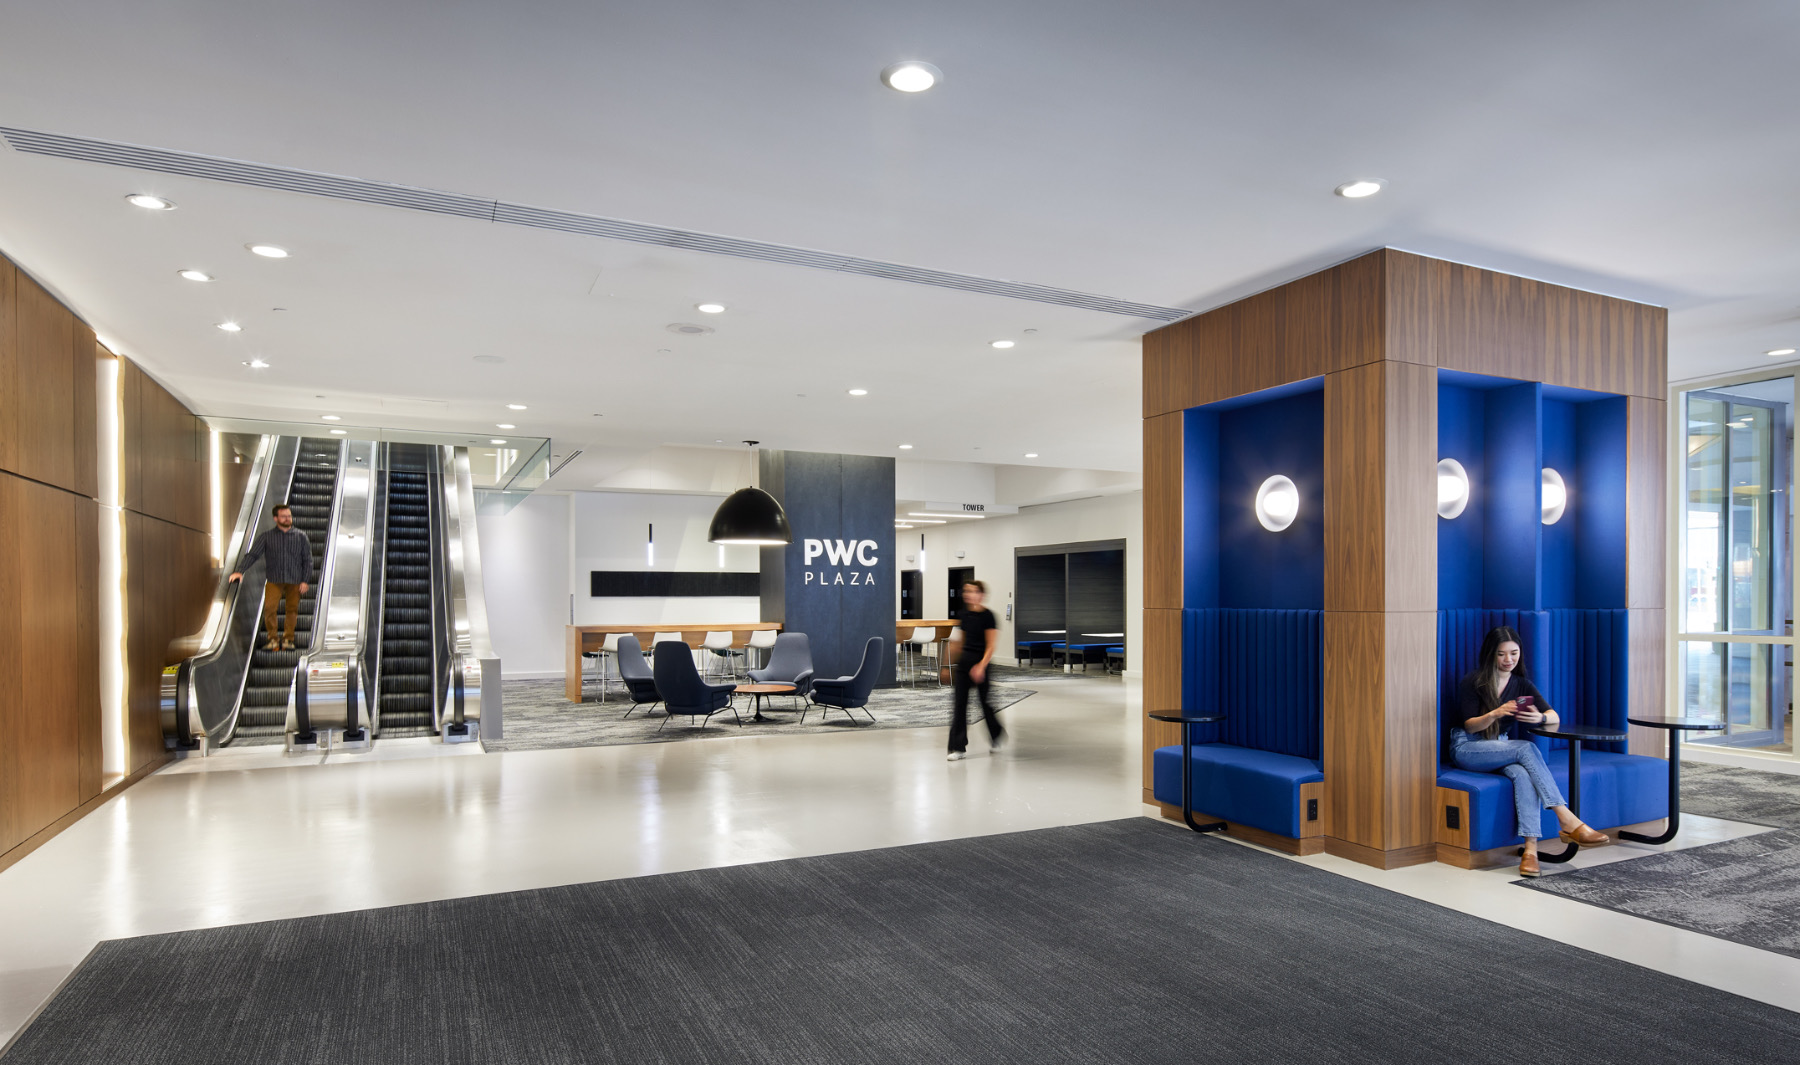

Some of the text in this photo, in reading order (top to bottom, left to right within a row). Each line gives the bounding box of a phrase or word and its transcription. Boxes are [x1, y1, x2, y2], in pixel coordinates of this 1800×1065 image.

[962, 503, 985, 512] TOWER
[804, 538, 879, 567] PWC
[804, 571, 876, 586] PLAZA
